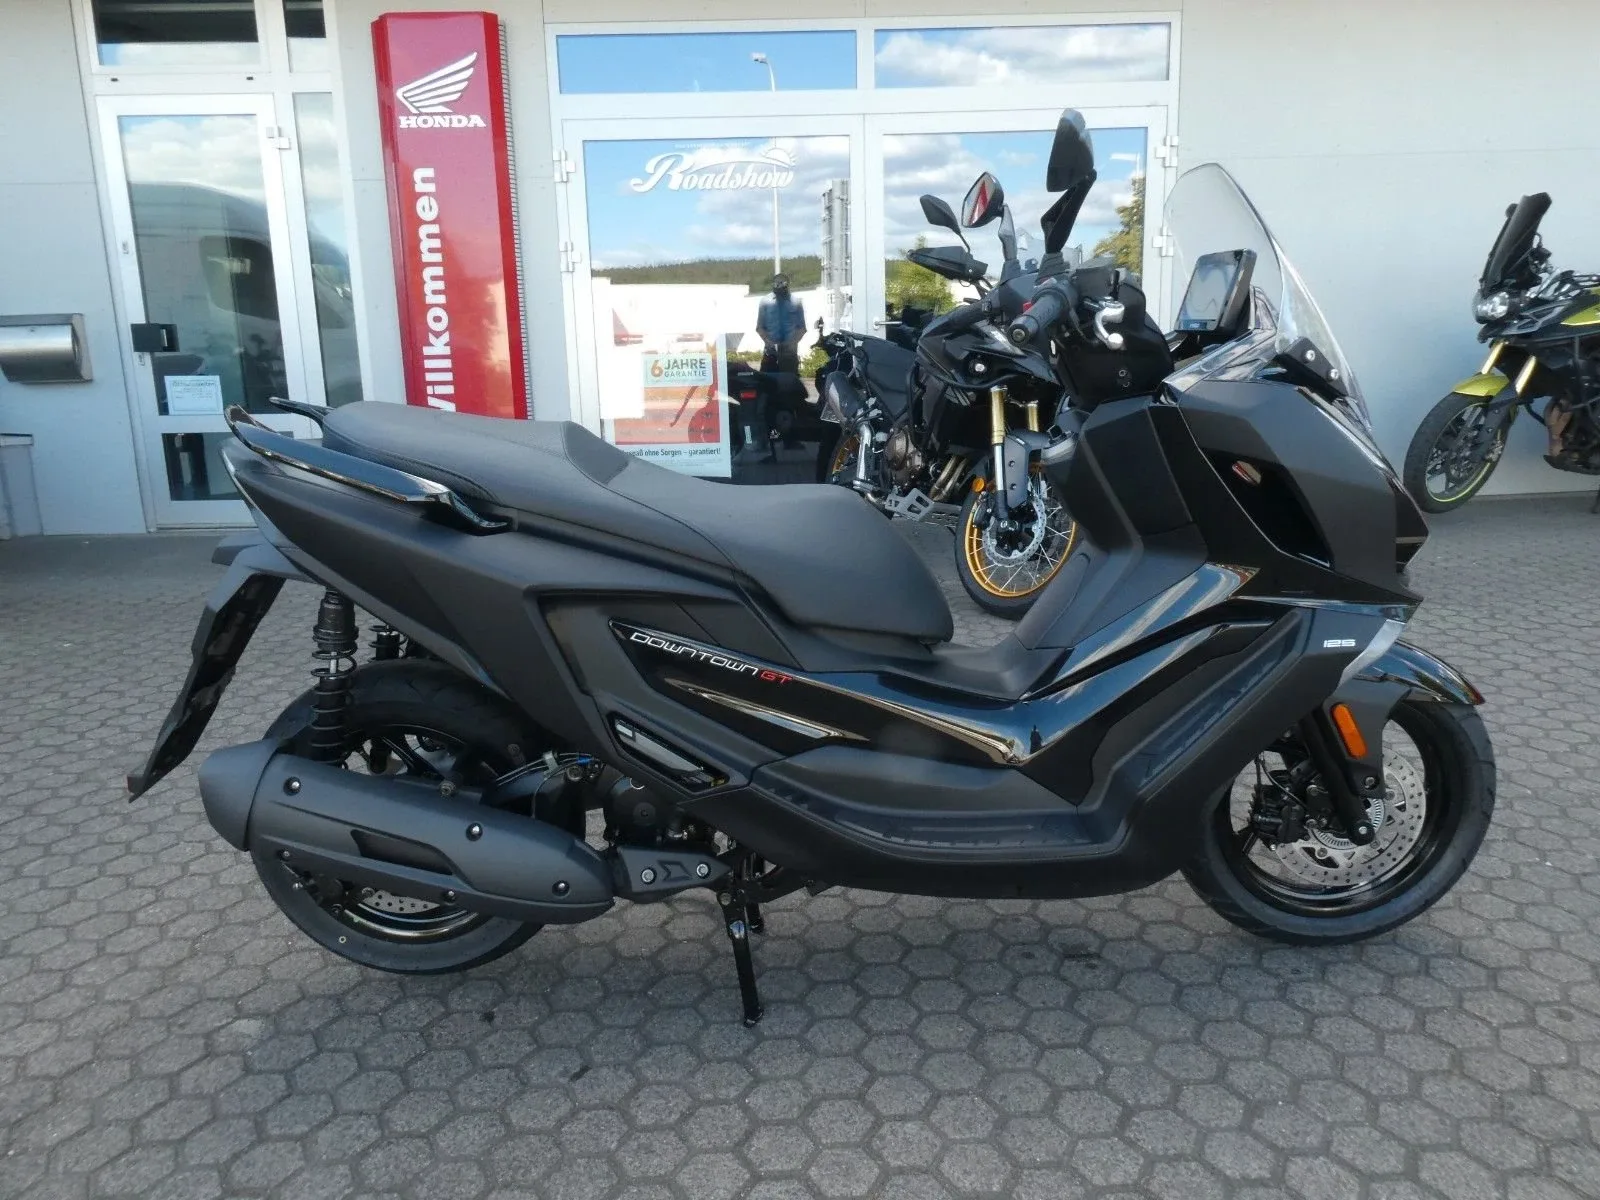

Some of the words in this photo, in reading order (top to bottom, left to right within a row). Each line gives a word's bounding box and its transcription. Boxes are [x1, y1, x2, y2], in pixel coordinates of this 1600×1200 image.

[398, 114, 487, 129] HONDA
[630, 152, 794, 193] Roadshow
[650, 359, 664, 377] 6
[664, 358, 707, 370] JAHRE
[664, 370, 707, 378] GARANTIE
[644, 448, 660, 457] ohne
[660, 448, 682, 458] Sorgen
[688, 447, 721, 457] garantiert!
[1323, 639, 1356, 648] 125
[759, 669, 793, 684] GT
